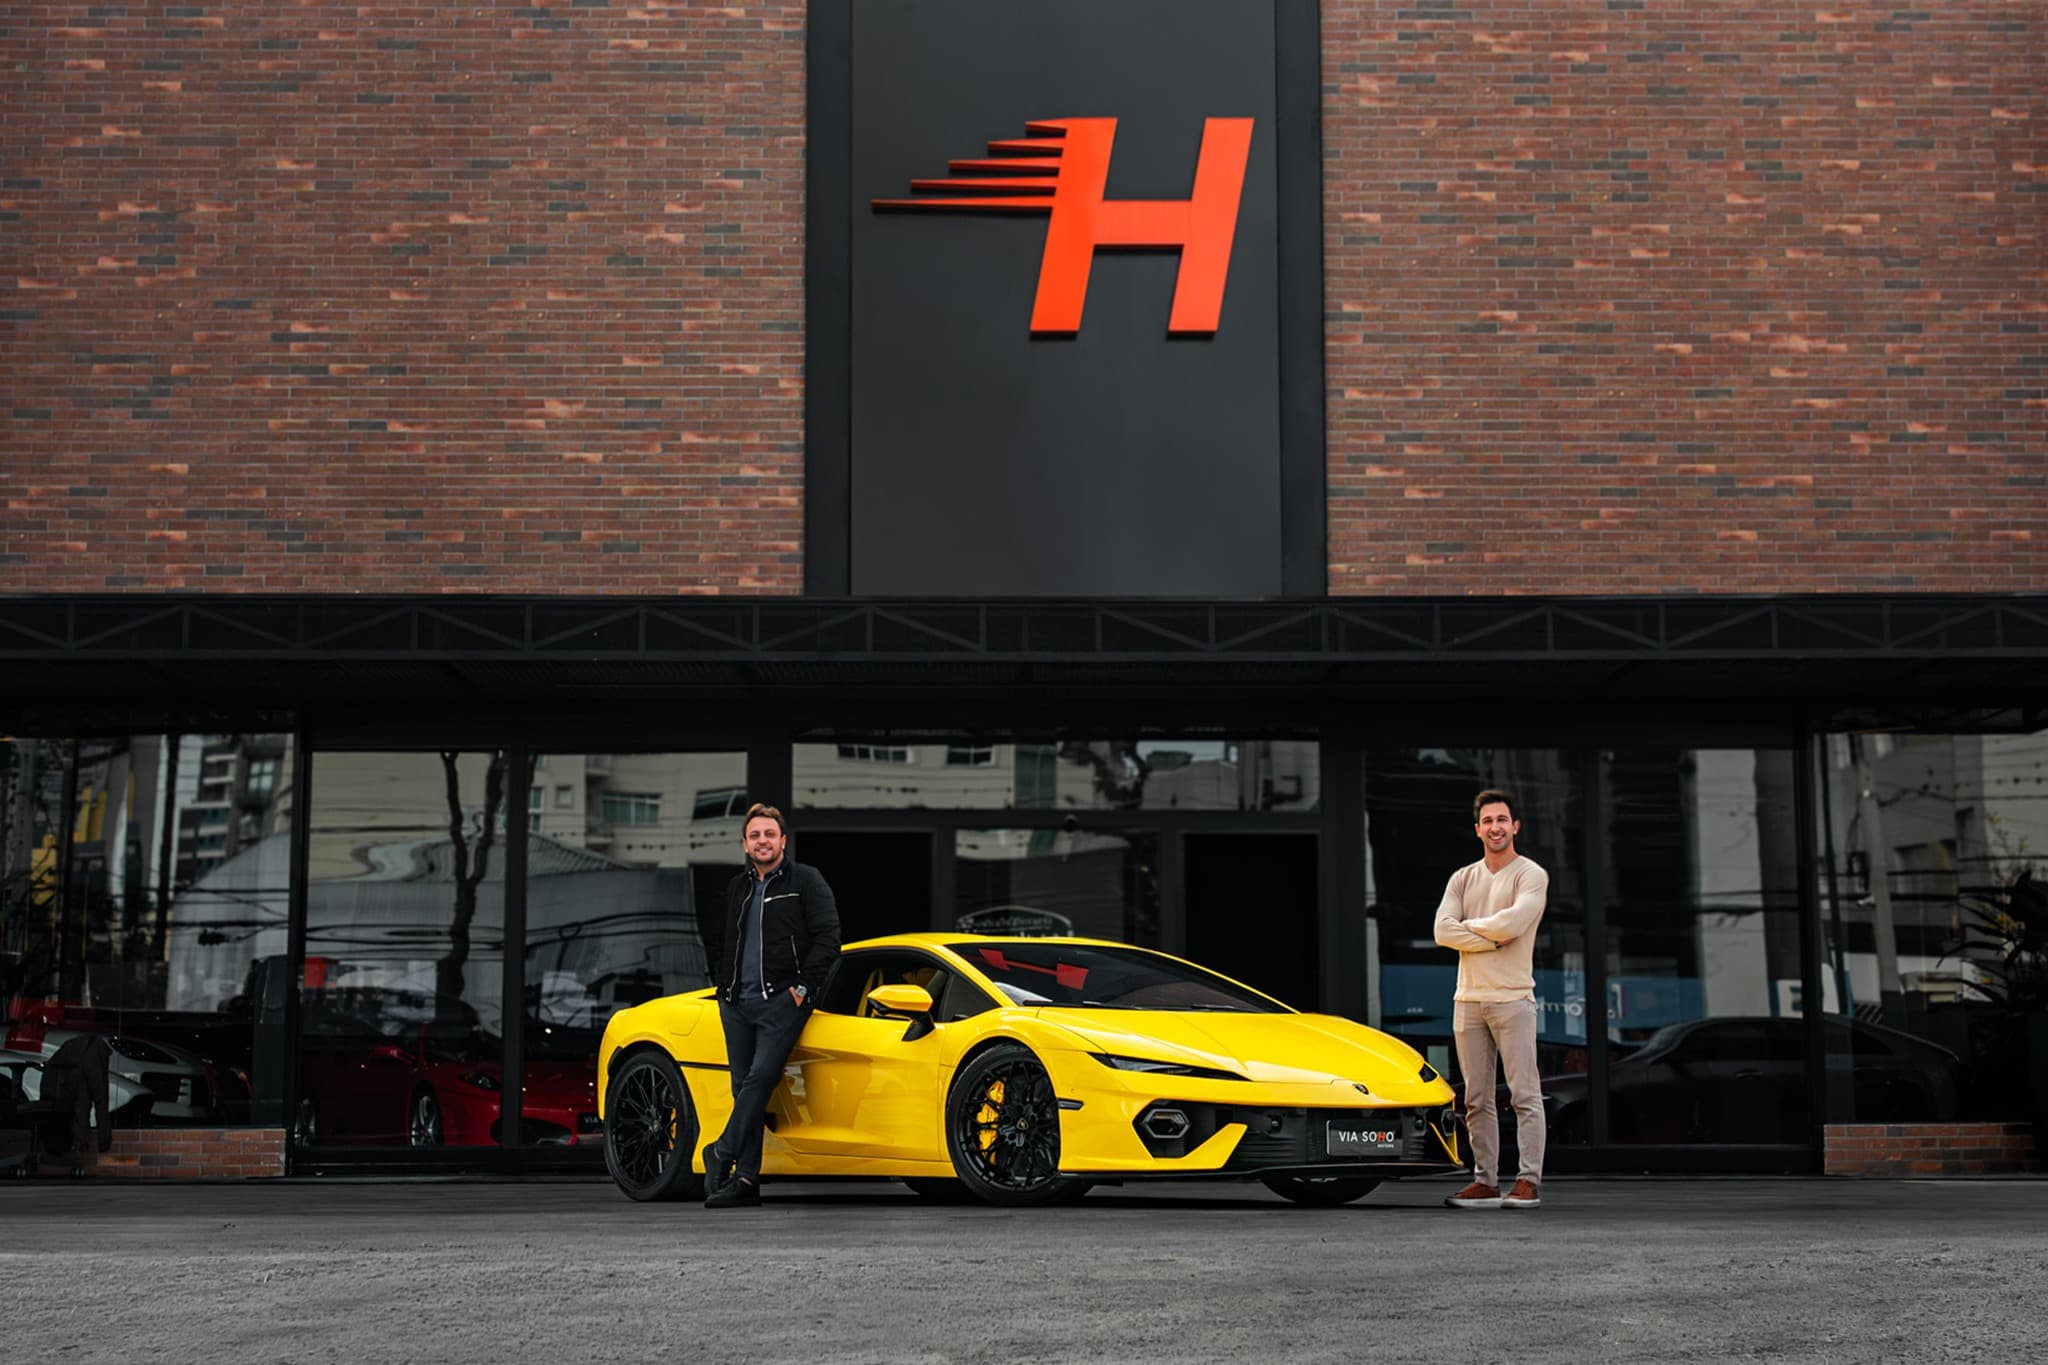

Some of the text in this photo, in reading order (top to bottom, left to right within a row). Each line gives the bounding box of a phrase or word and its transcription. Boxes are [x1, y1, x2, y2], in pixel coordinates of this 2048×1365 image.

[872, 117, 1255, 332] H
[1338, 1131, 1394, 1142] VIA SOHO
